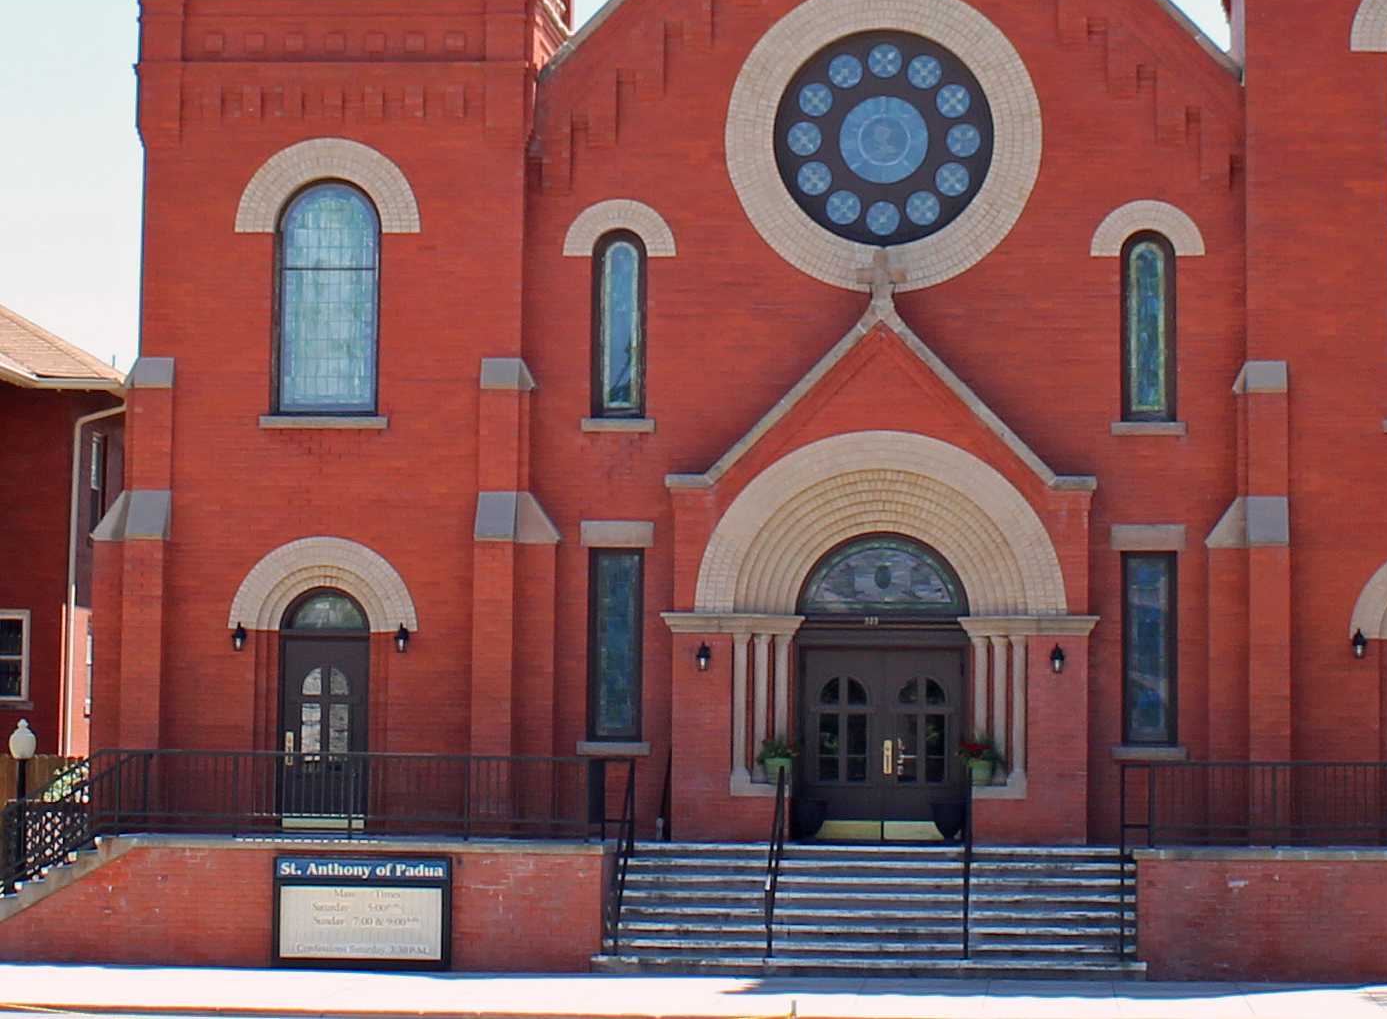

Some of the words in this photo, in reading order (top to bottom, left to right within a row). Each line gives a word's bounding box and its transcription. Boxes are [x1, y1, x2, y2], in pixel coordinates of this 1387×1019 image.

[280, 862, 302, 876] St.
[306, 862, 372, 880] Anthony
[375, 863, 394, 877] of
[396, 864, 444, 877] Padua
[334, 889, 355, 898] Mass
[375, 890, 401, 898] Times
[312, 902, 349, 912] Saturday
[313, 915, 345, 926] Sunday
[375, 917, 384, 926] &
